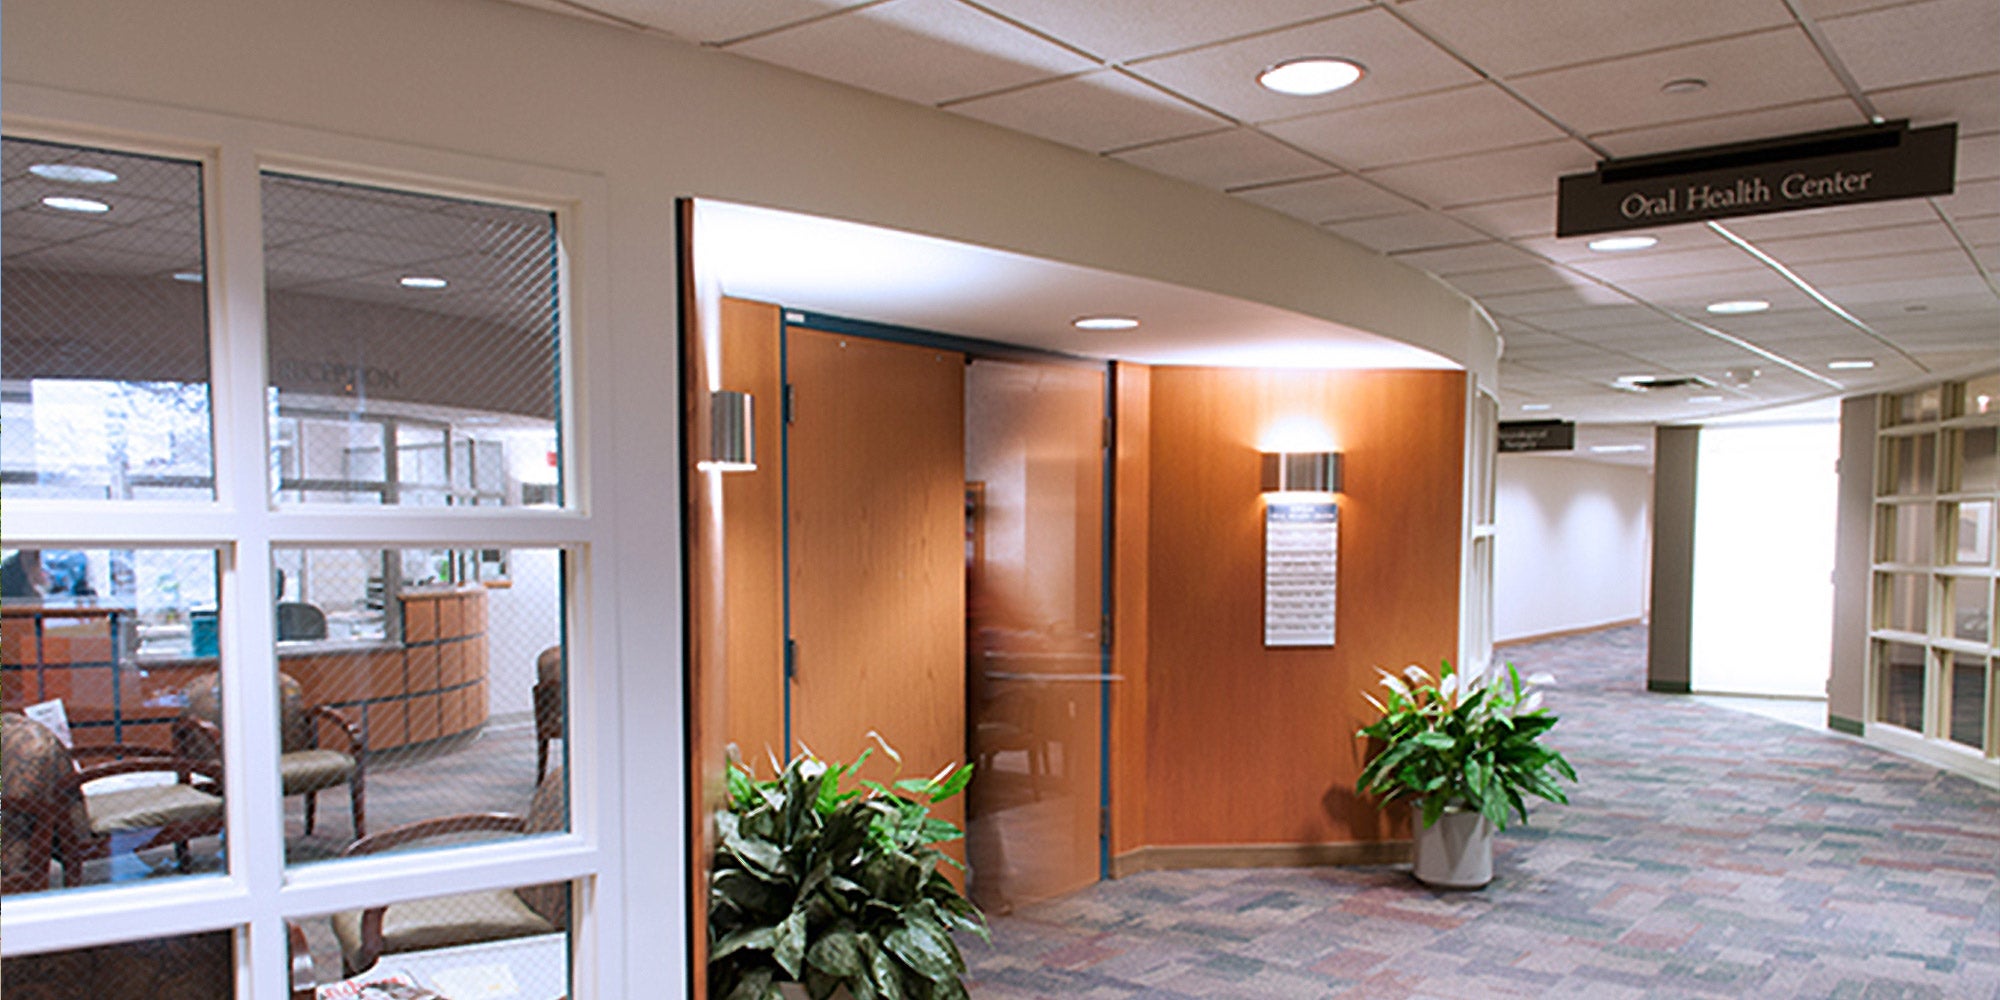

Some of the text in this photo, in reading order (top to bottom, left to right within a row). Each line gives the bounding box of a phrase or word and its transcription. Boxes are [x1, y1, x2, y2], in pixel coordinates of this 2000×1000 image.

[1621, 170, 1872, 219] Oral Health Center
